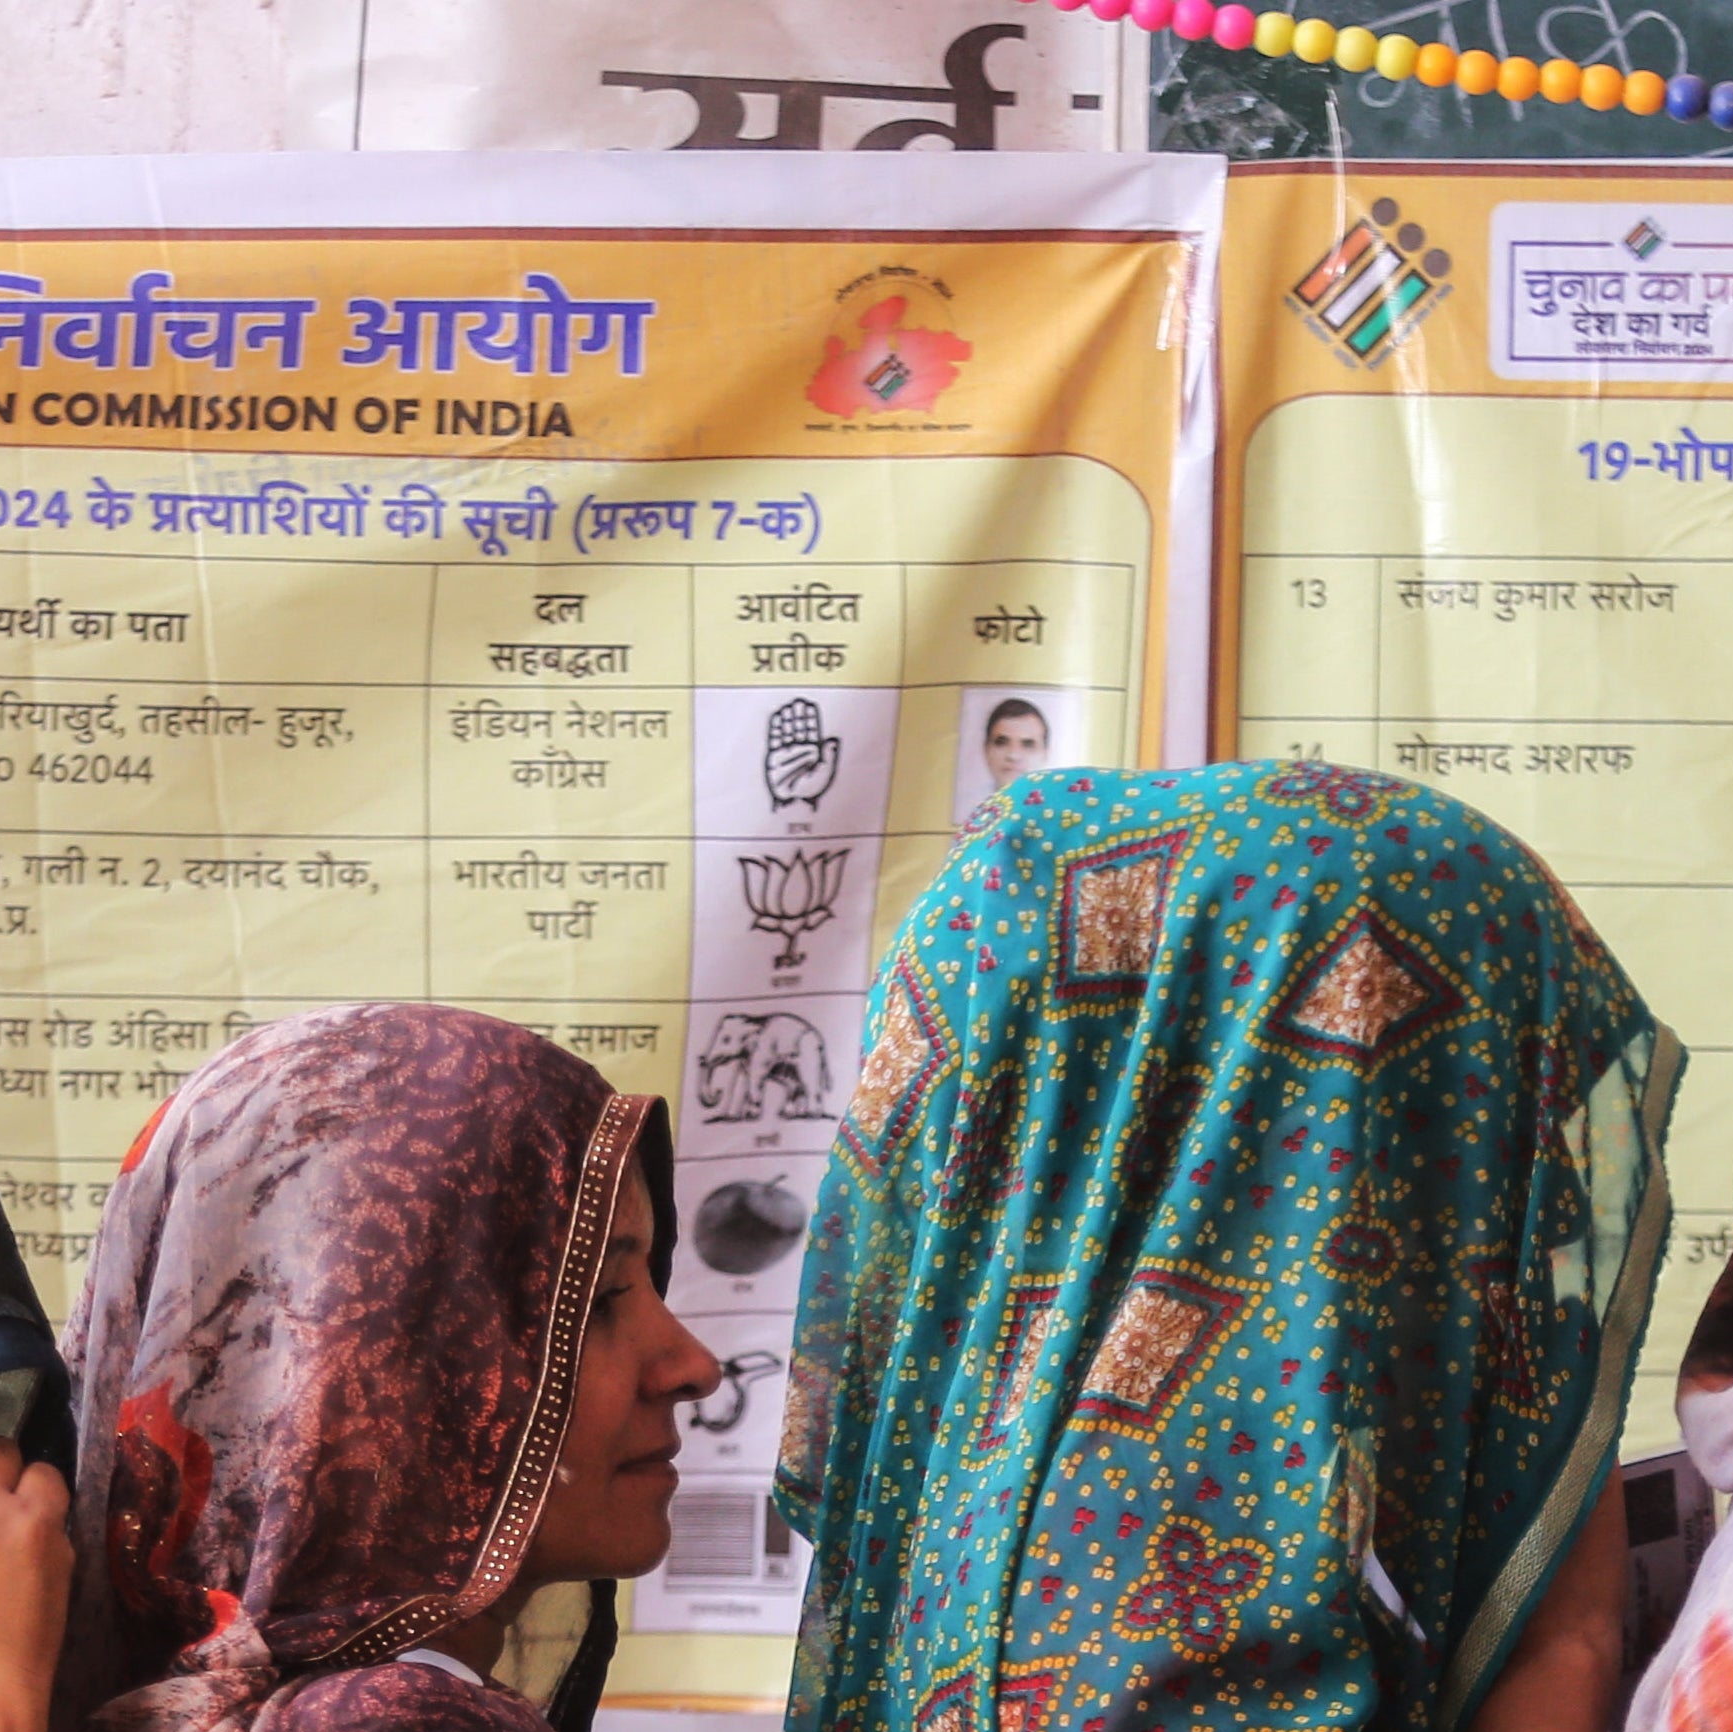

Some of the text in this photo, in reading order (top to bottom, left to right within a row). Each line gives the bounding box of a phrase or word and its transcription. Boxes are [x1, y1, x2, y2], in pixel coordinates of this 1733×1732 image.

[1522, 271, 1627, 318] चुनाव
[1638, 273, 1694, 303] का
[344, 275, 654, 375] आयोग
[1571, 303, 1712, 338] देश का गर्व
[32, 391, 337, 433] COMMISSION
[354, 398, 419, 434] OF
[435, 400, 574, 439] INDIA
[88, 476, 136, 531] के
[149, 481, 368, 539] प्रत्याशियों
[384, 484, 447, 539] की
[463, 486, 556, 555] सूची
[574, 493, 695, 555] (प्ररूप
[712, 491, 823, 555] 7-क)
[534, 593, 587, 624] दल
[737, 583, 862, 624] आवंटित
[1289, 580, 1328, 609] 13
[1395, 571, 1677, 622] संजय कुमार सरोज
[70, 609, 114, 642] का
[128, 611, 189, 643] पता
[975, 605, 1047, 646] फोटो
[488, 643, 632, 679] सहबद्धता
[751, 636, 847, 674] प्रतीक
[139, 696, 265, 738] तहसील-
[450, 698, 670, 741] इंडियन नेशनल
[28, 754, 154, 787] 462044
[1394, 733, 1635, 776] मोहम्मद अशरफ
[22, 847, 87, 888] गली
[98, 854, 128, 888] न.
[183, 848, 287, 892] दयानंद
[299, 850, 379, 895] चौक,
[454, 850, 666, 892] भारतीय जनता
[528, 901, 597, 941] पार्टी
[44, 1010, 96, 1049] रोड
[567, 1025, 660, 1053] समाज
[60, 1070, 123, 1099] नगर
